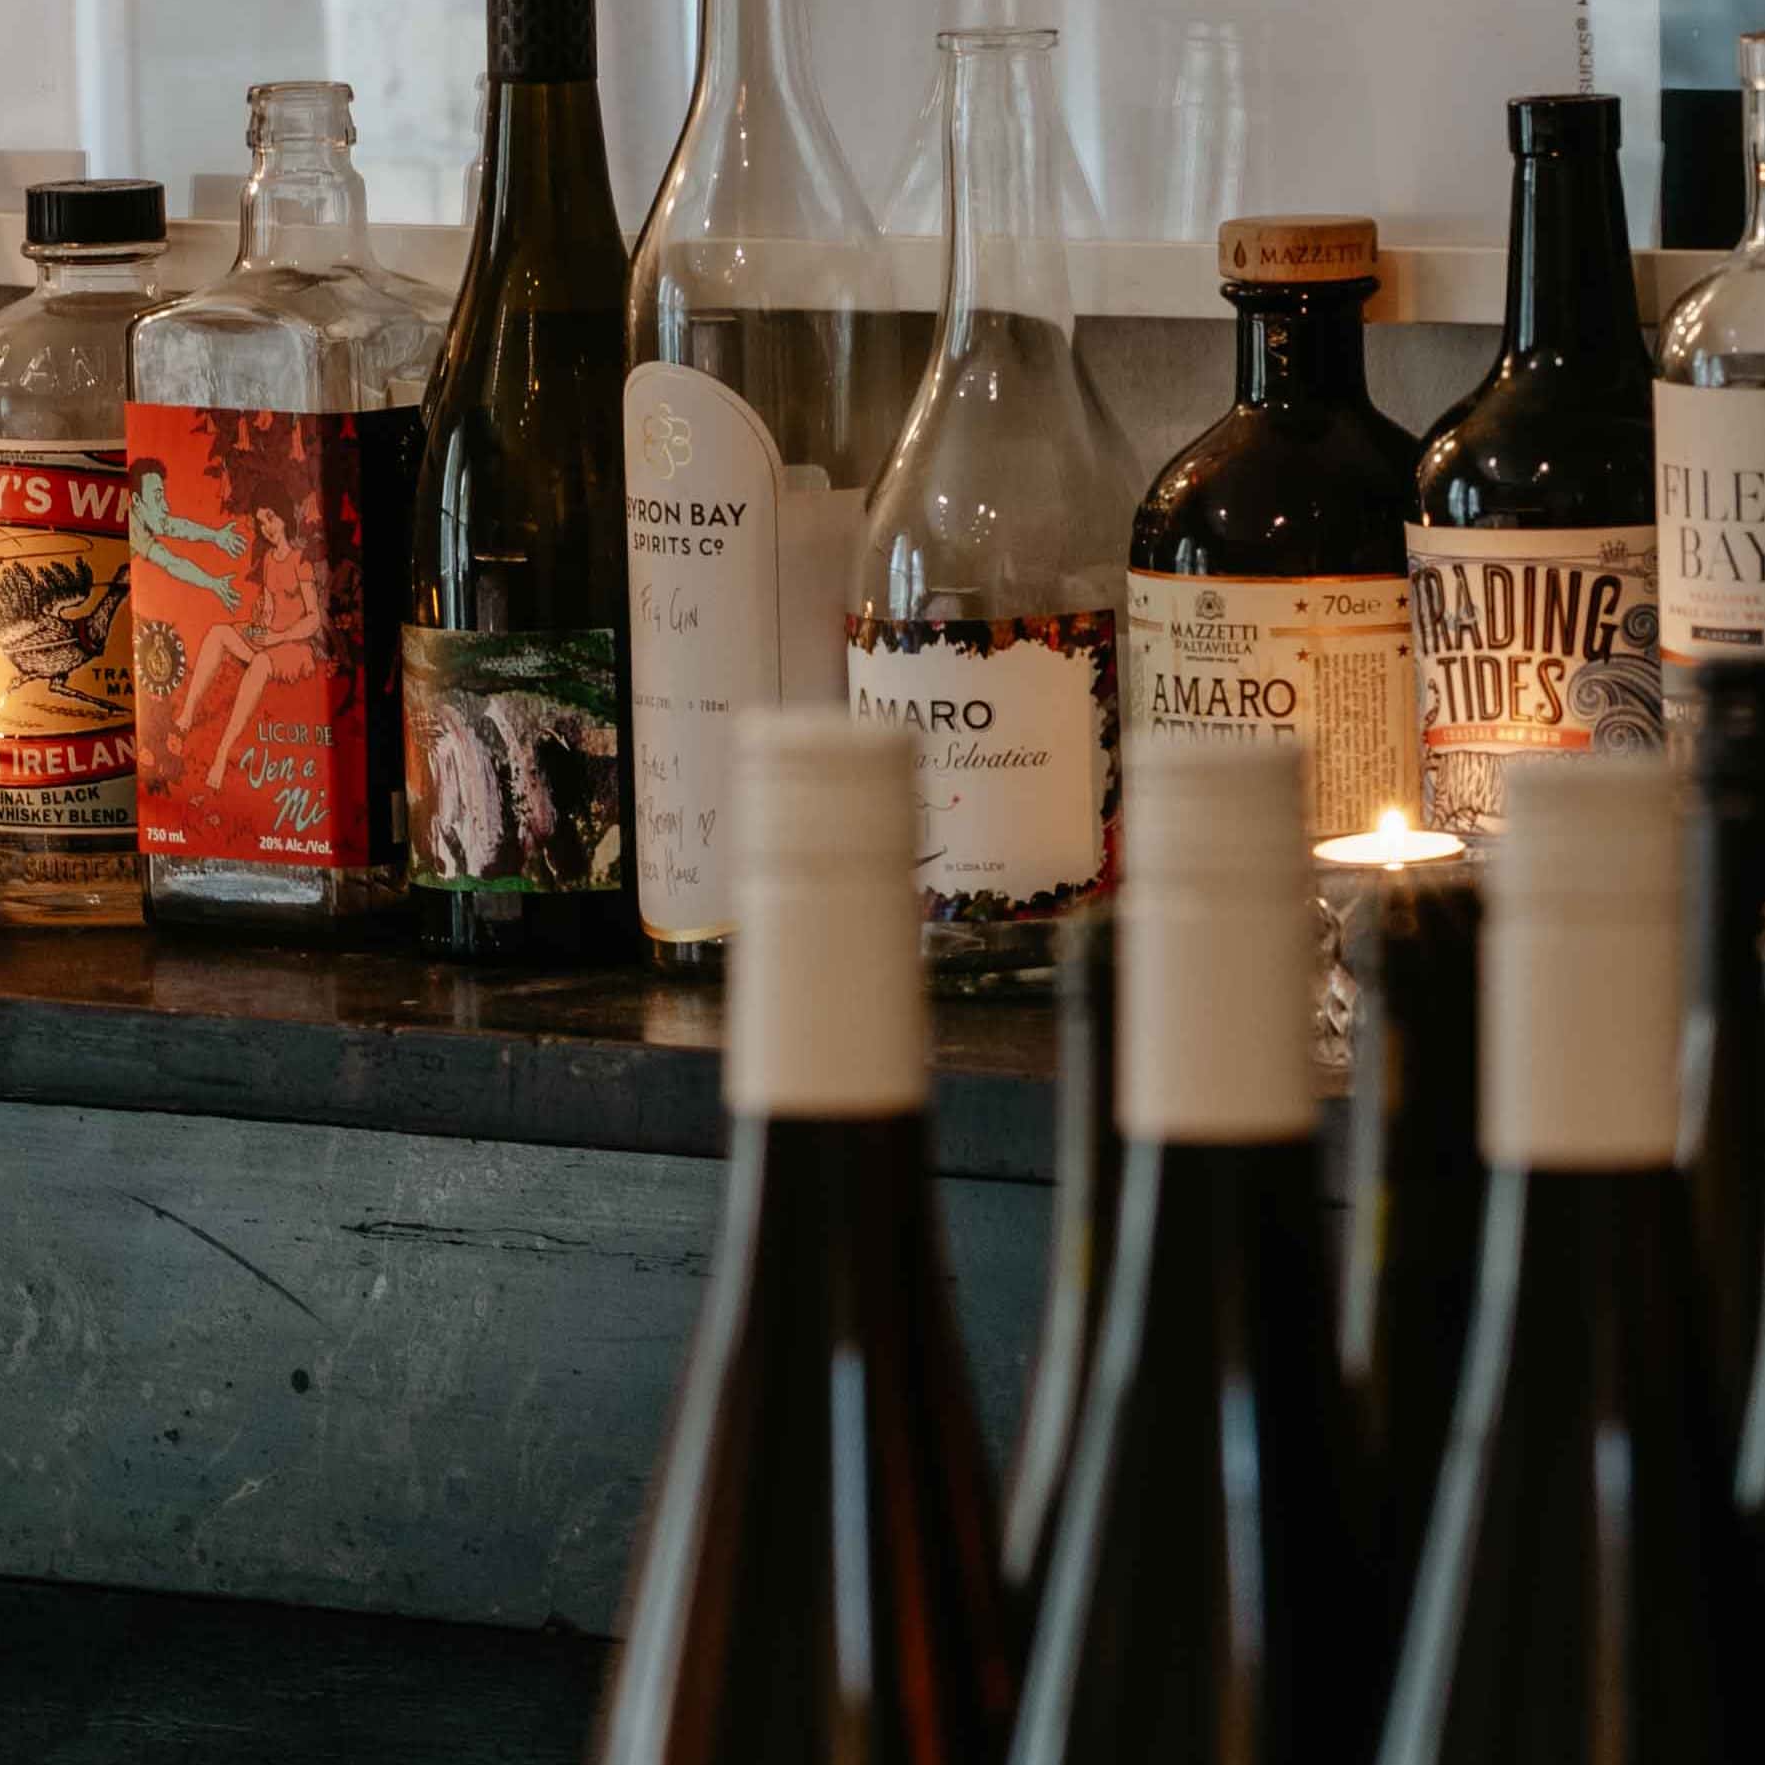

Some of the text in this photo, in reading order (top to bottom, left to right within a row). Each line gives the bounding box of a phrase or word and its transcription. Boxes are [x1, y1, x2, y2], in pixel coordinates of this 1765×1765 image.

[627, 495, 747, 527] BYRON BAY
[634, 532, 691, 556] SPIRITS
[1412, 563, 1621, 665] TRADING
[1170, 622, 1258, 642] MAZZETTI
[92, 666, 129, 682] TRA
[107, 682, 135, 696] MA
[1152, 673, 1297, 718] AMARO
[1436, 656, 1566, 725] TIDES
[857, 687, 993, 732] AMARO
[258, 722, 334, 747] LICOR DE
[12, 736, 135, 777] IRELAN
[934, 740, 1052, 771] Selvatica
[40, 786, 101, 806] BLACK
[68, 807, 129, 824] BLEND
[146, 827, 167, 842] 750
[259, 836, 285, 852] 20%
